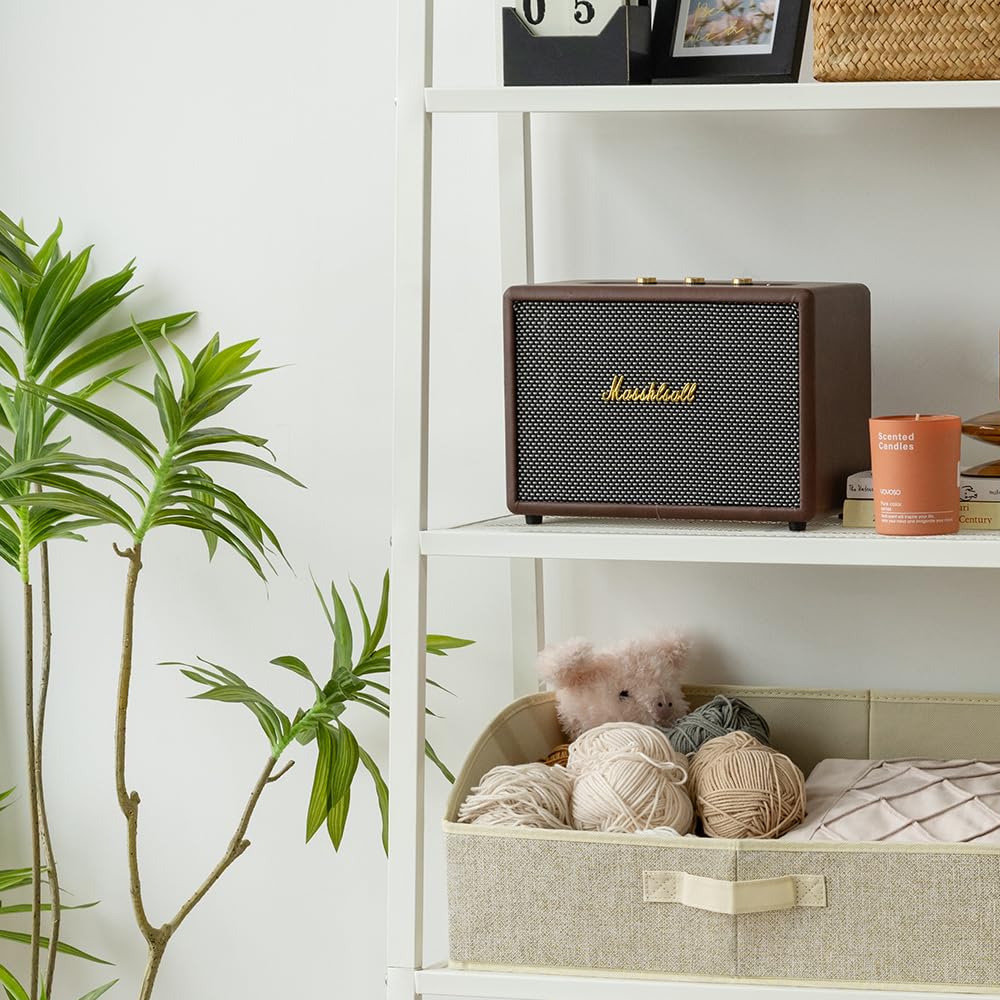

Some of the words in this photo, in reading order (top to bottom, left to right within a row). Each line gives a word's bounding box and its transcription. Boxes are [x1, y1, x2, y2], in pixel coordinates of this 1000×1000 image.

[878, 432, 915, 441] Scented
[878, 442, 915, 451] Candles
[960, 514, 992, 525] Century
